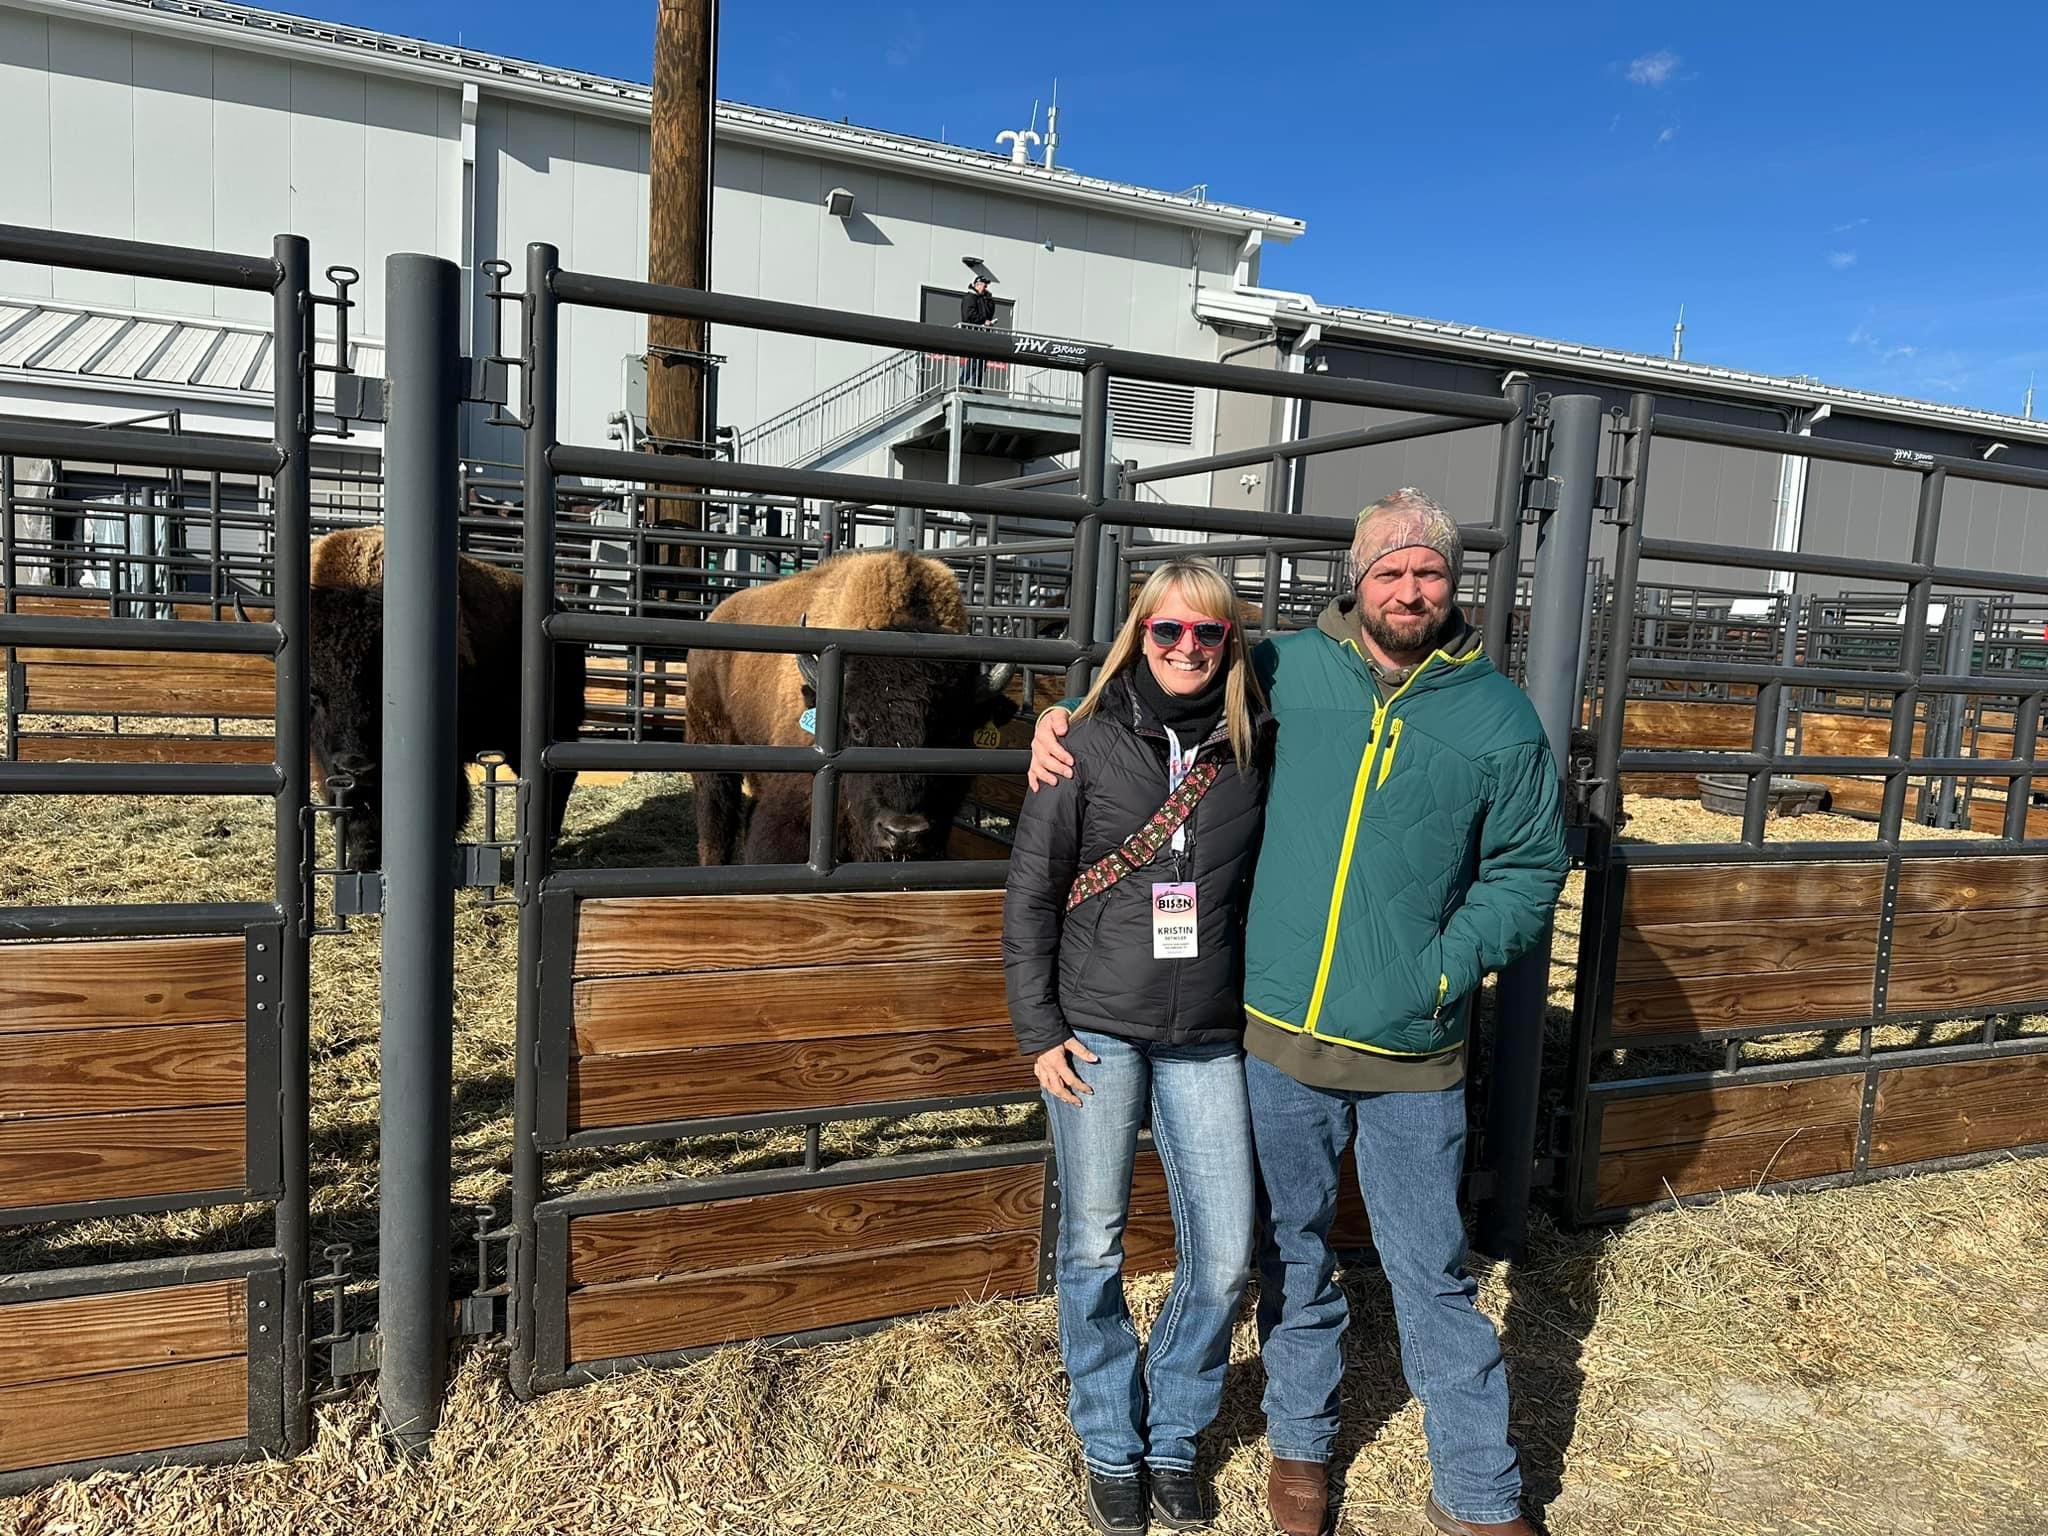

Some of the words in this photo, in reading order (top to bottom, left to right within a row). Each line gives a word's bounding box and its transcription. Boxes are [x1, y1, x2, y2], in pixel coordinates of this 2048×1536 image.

[1050, 344, 1087, 355] BRAND
[976, 730, 998, 746] 228
[1158, 899, 1192, 909] BISON
[1157, 926, 1193, 935] KRISTIN
